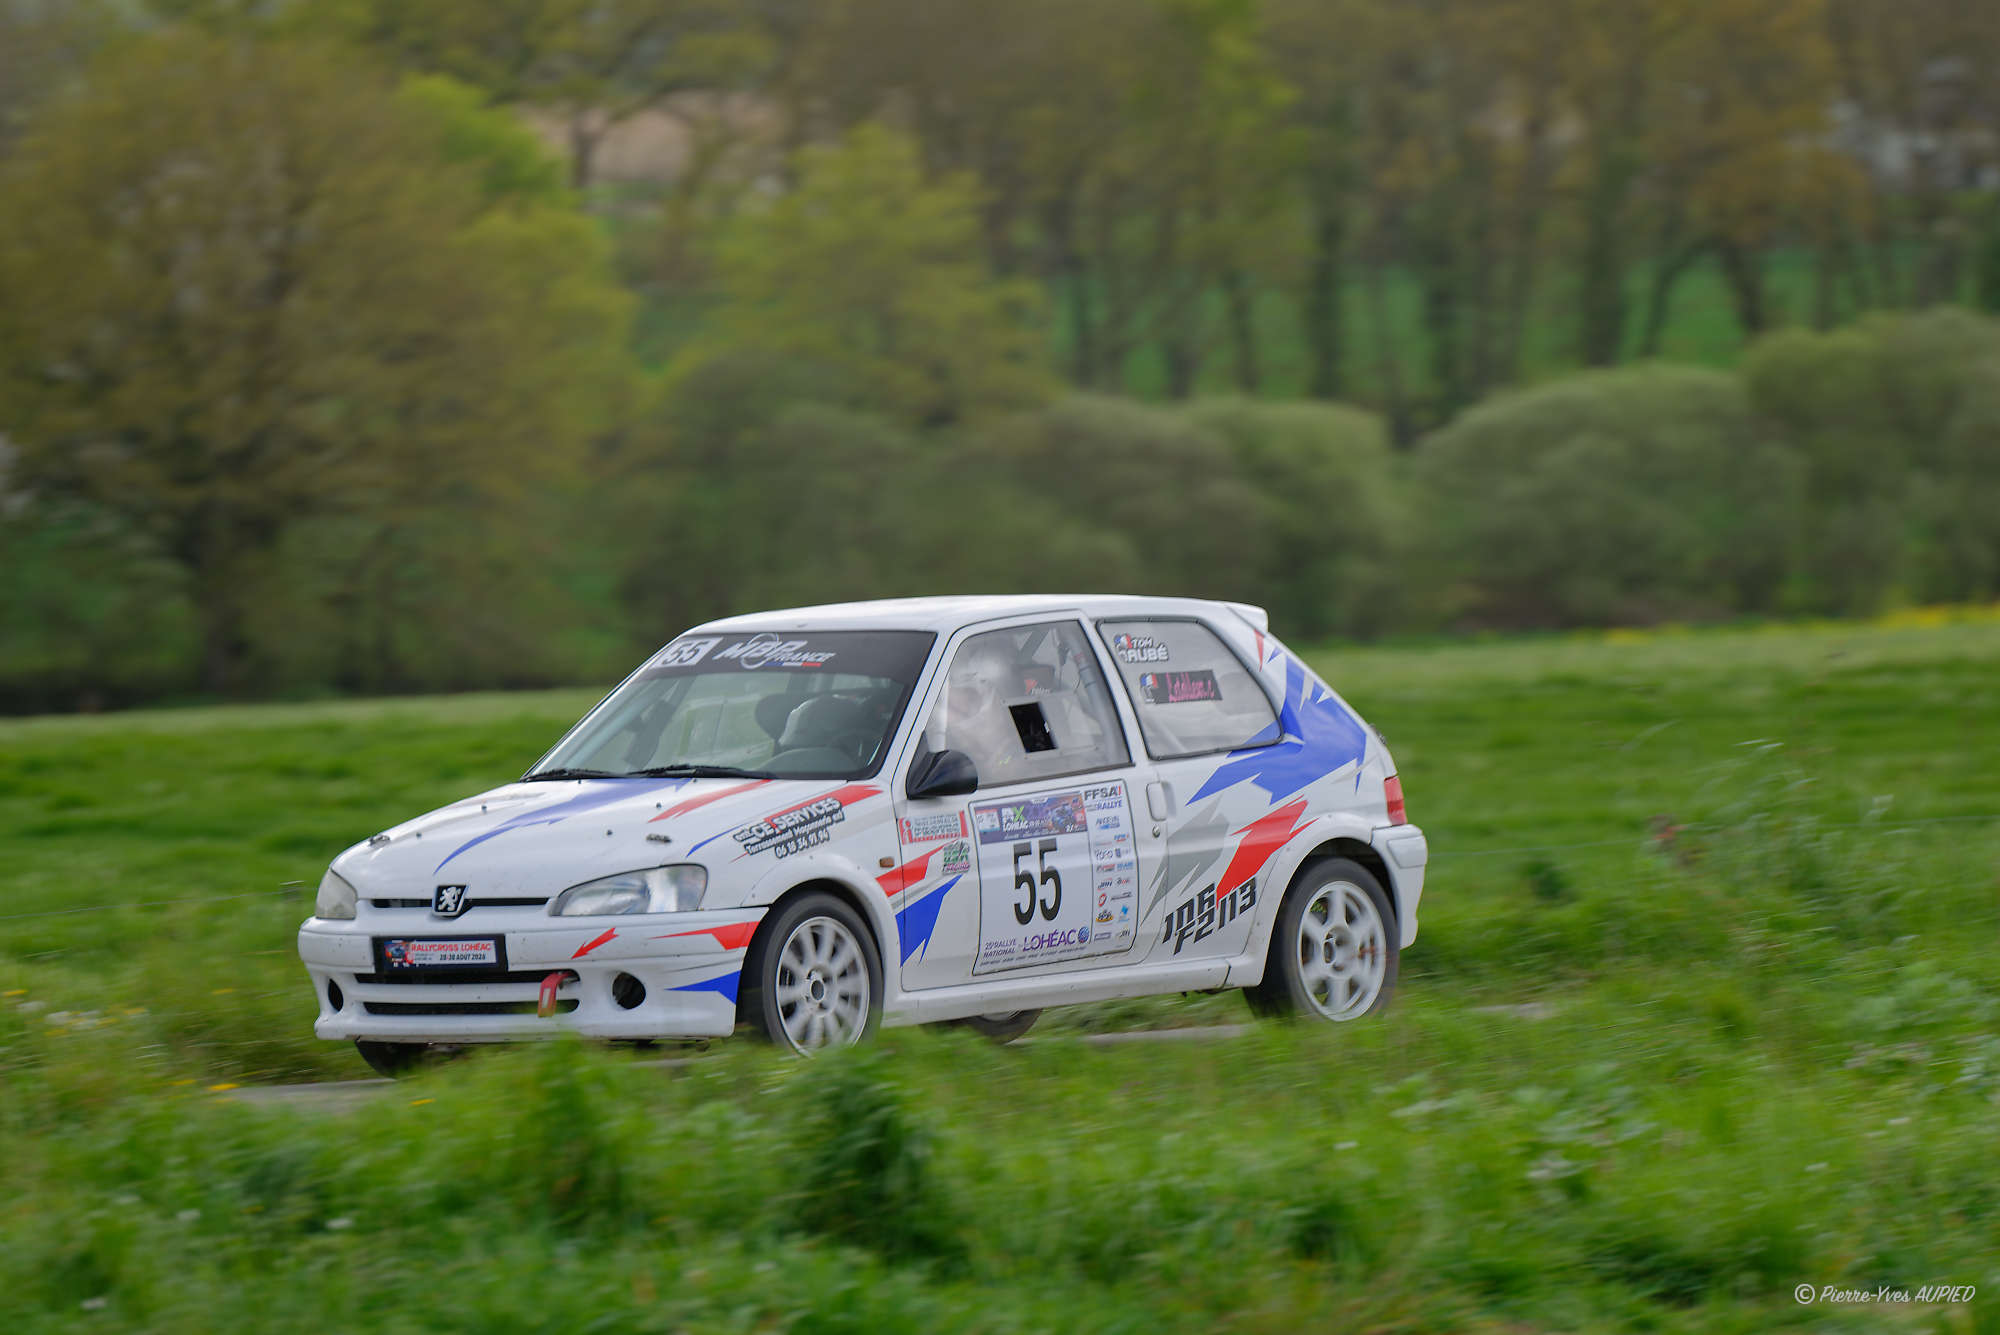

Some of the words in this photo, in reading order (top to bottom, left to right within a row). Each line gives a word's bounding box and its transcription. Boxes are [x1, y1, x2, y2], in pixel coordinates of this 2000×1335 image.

[661, 640, 708, 665] 55
[769, 652, 836, 663] FRANCE
[1084, 786, 1118, 800] FFSA
[773, 797, 842, 831] SERVICES
[1013, 837, 1062, 925] 55
[411, 943, 458, 952] RALLYCROSS
[461, 942, 492, 952] LOHÉAC
[1023, 929, 1077, 952] LOHÉAC
[984, 948, 1016, 959] NATIONAL
